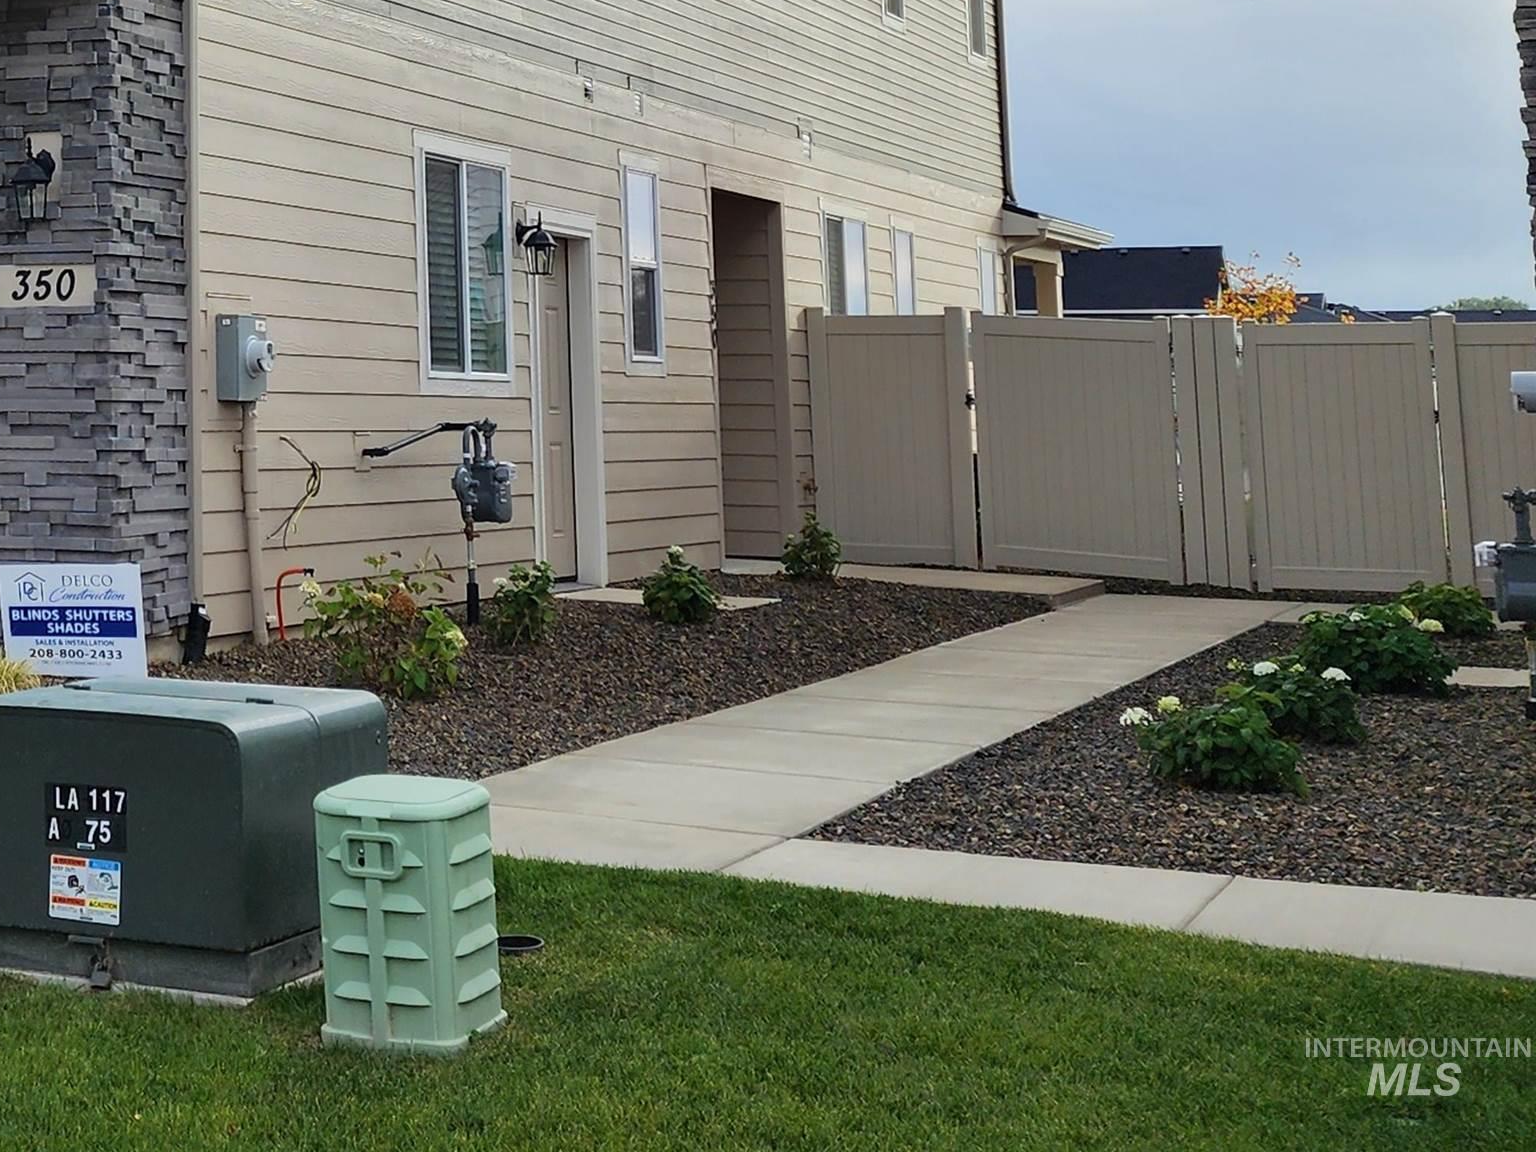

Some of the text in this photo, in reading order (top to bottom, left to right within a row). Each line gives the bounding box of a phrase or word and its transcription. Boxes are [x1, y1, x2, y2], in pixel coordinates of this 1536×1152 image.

[11, 269, 75, 301] 350
[61, 575, 113, 587] DELCO
[49, 588, 125, 603] Construction
[11, 609, 133, 622] BLINDS SHUTTERS
[47, 622, 100, 634] SHADES
[64, 639, 114, 647] INSTALLATION
[29, 648, 123, 660] 208-800-2433
[55, 786, 126, 814] LA 117
[48, 817, 112, 844] A 75
